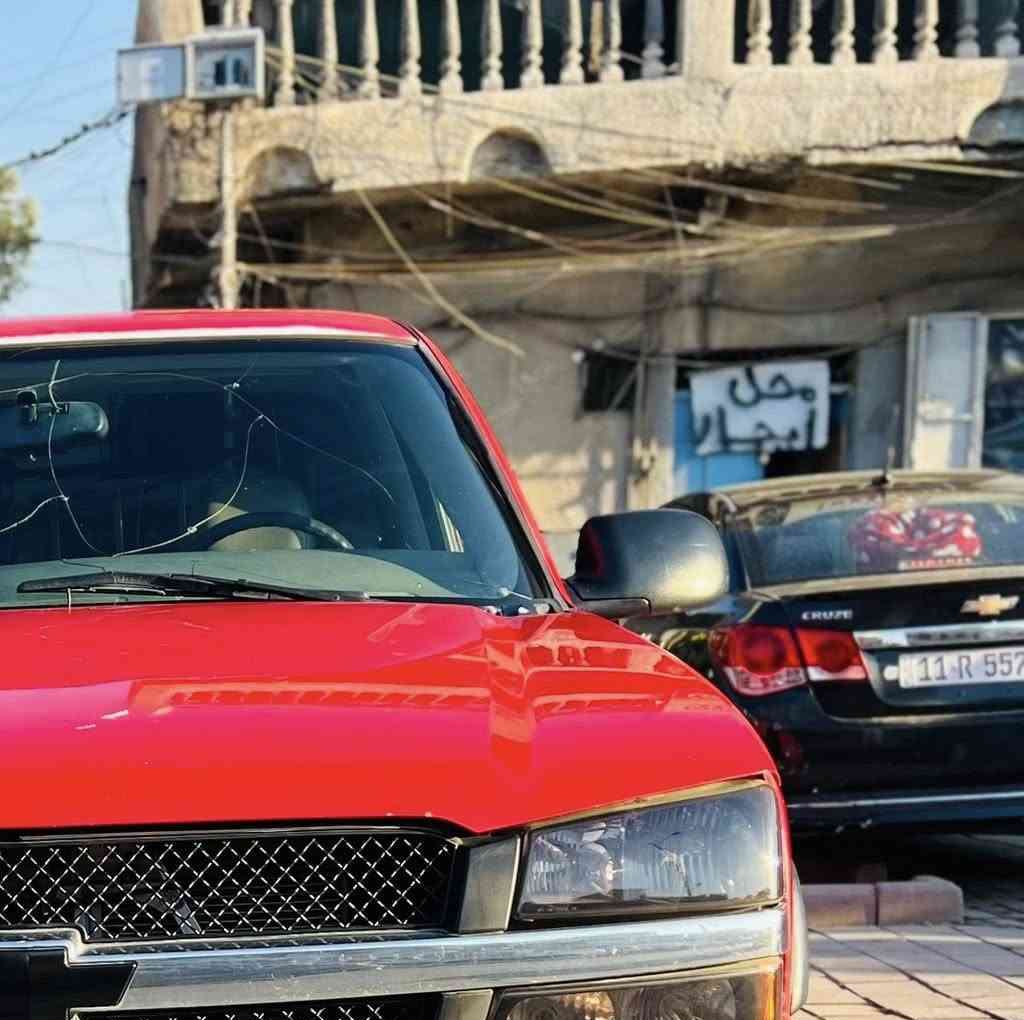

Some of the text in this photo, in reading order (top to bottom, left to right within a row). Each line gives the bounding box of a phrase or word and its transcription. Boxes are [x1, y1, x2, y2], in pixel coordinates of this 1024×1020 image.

[729, 367, 816, 408] محل
[801, 609, 854, 621] CRUZE
[918, 656, 946, 681] 11
[958, 655, 973, 679] R
